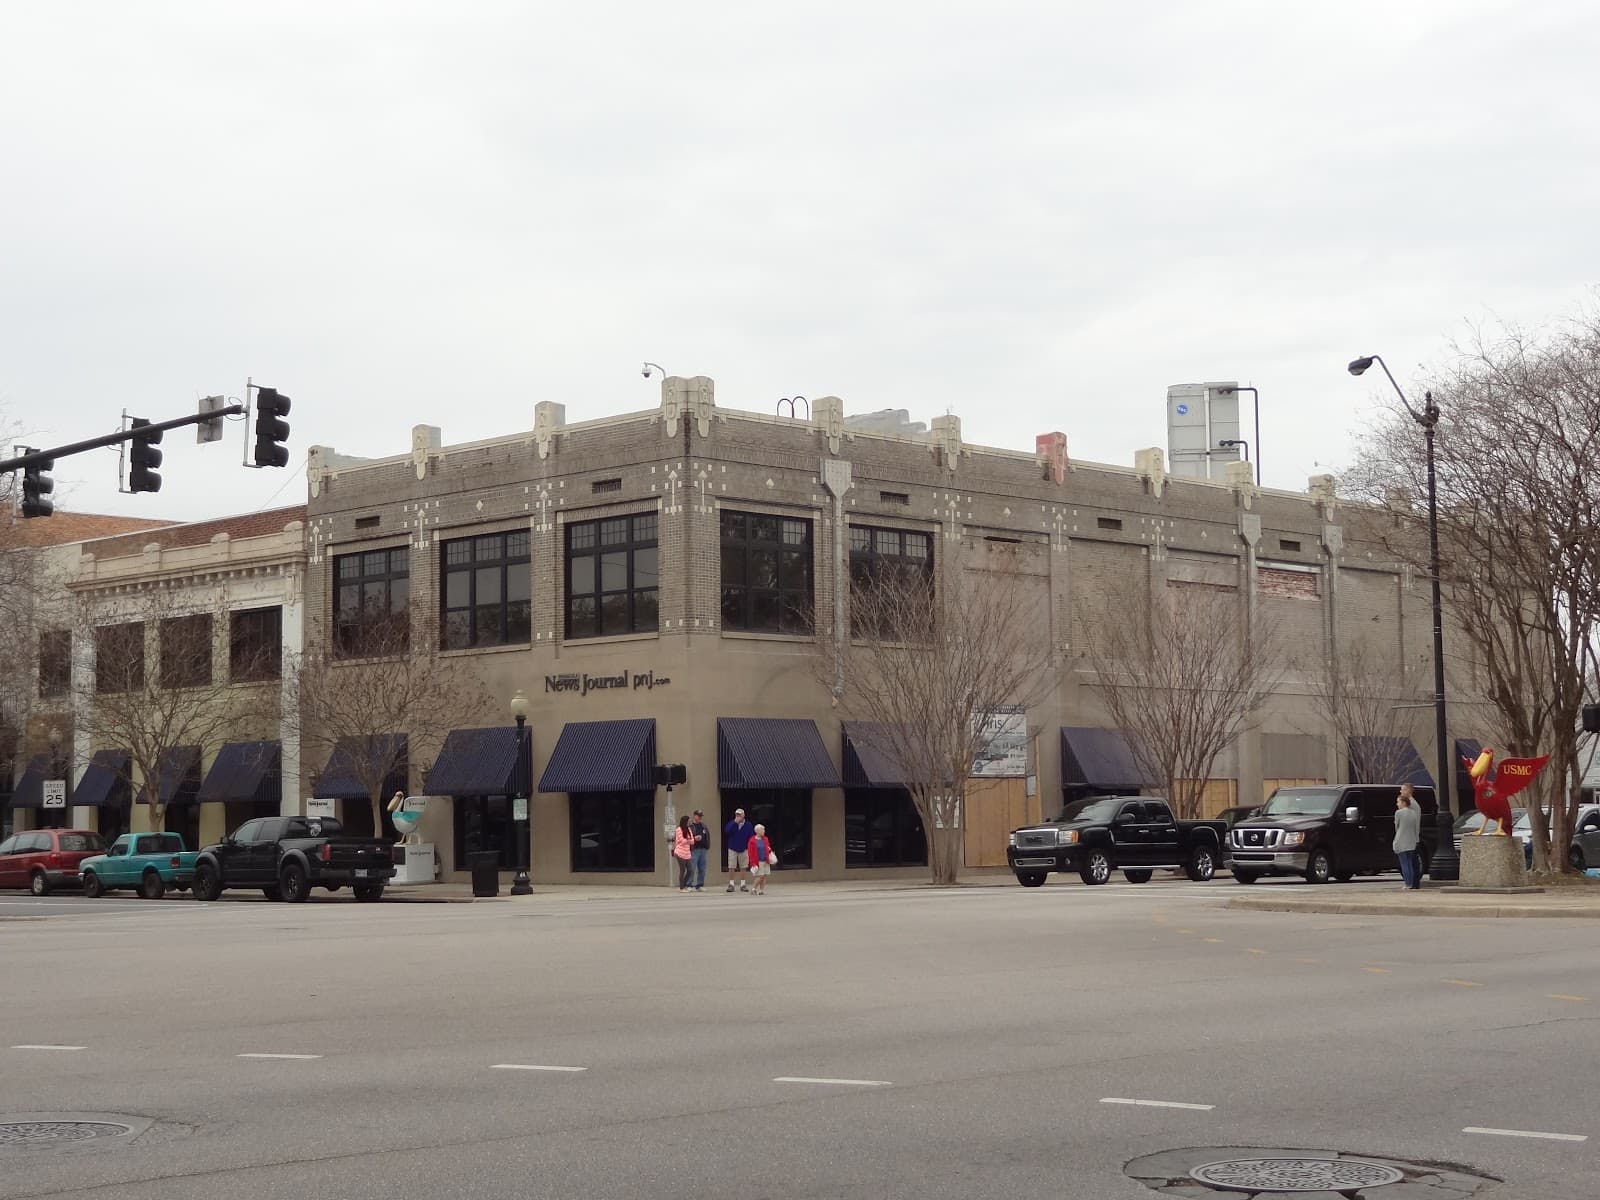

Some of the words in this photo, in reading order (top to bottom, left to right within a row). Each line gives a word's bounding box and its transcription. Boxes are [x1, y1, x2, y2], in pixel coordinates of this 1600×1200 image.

[545, 675, 579, 693] News
[581, 670, 628, 697] Journal
[633, 669, 671, 691] pnj.com
[1503, 764, 1532, 776] USMC
[46, 794, 63, 805] 25
